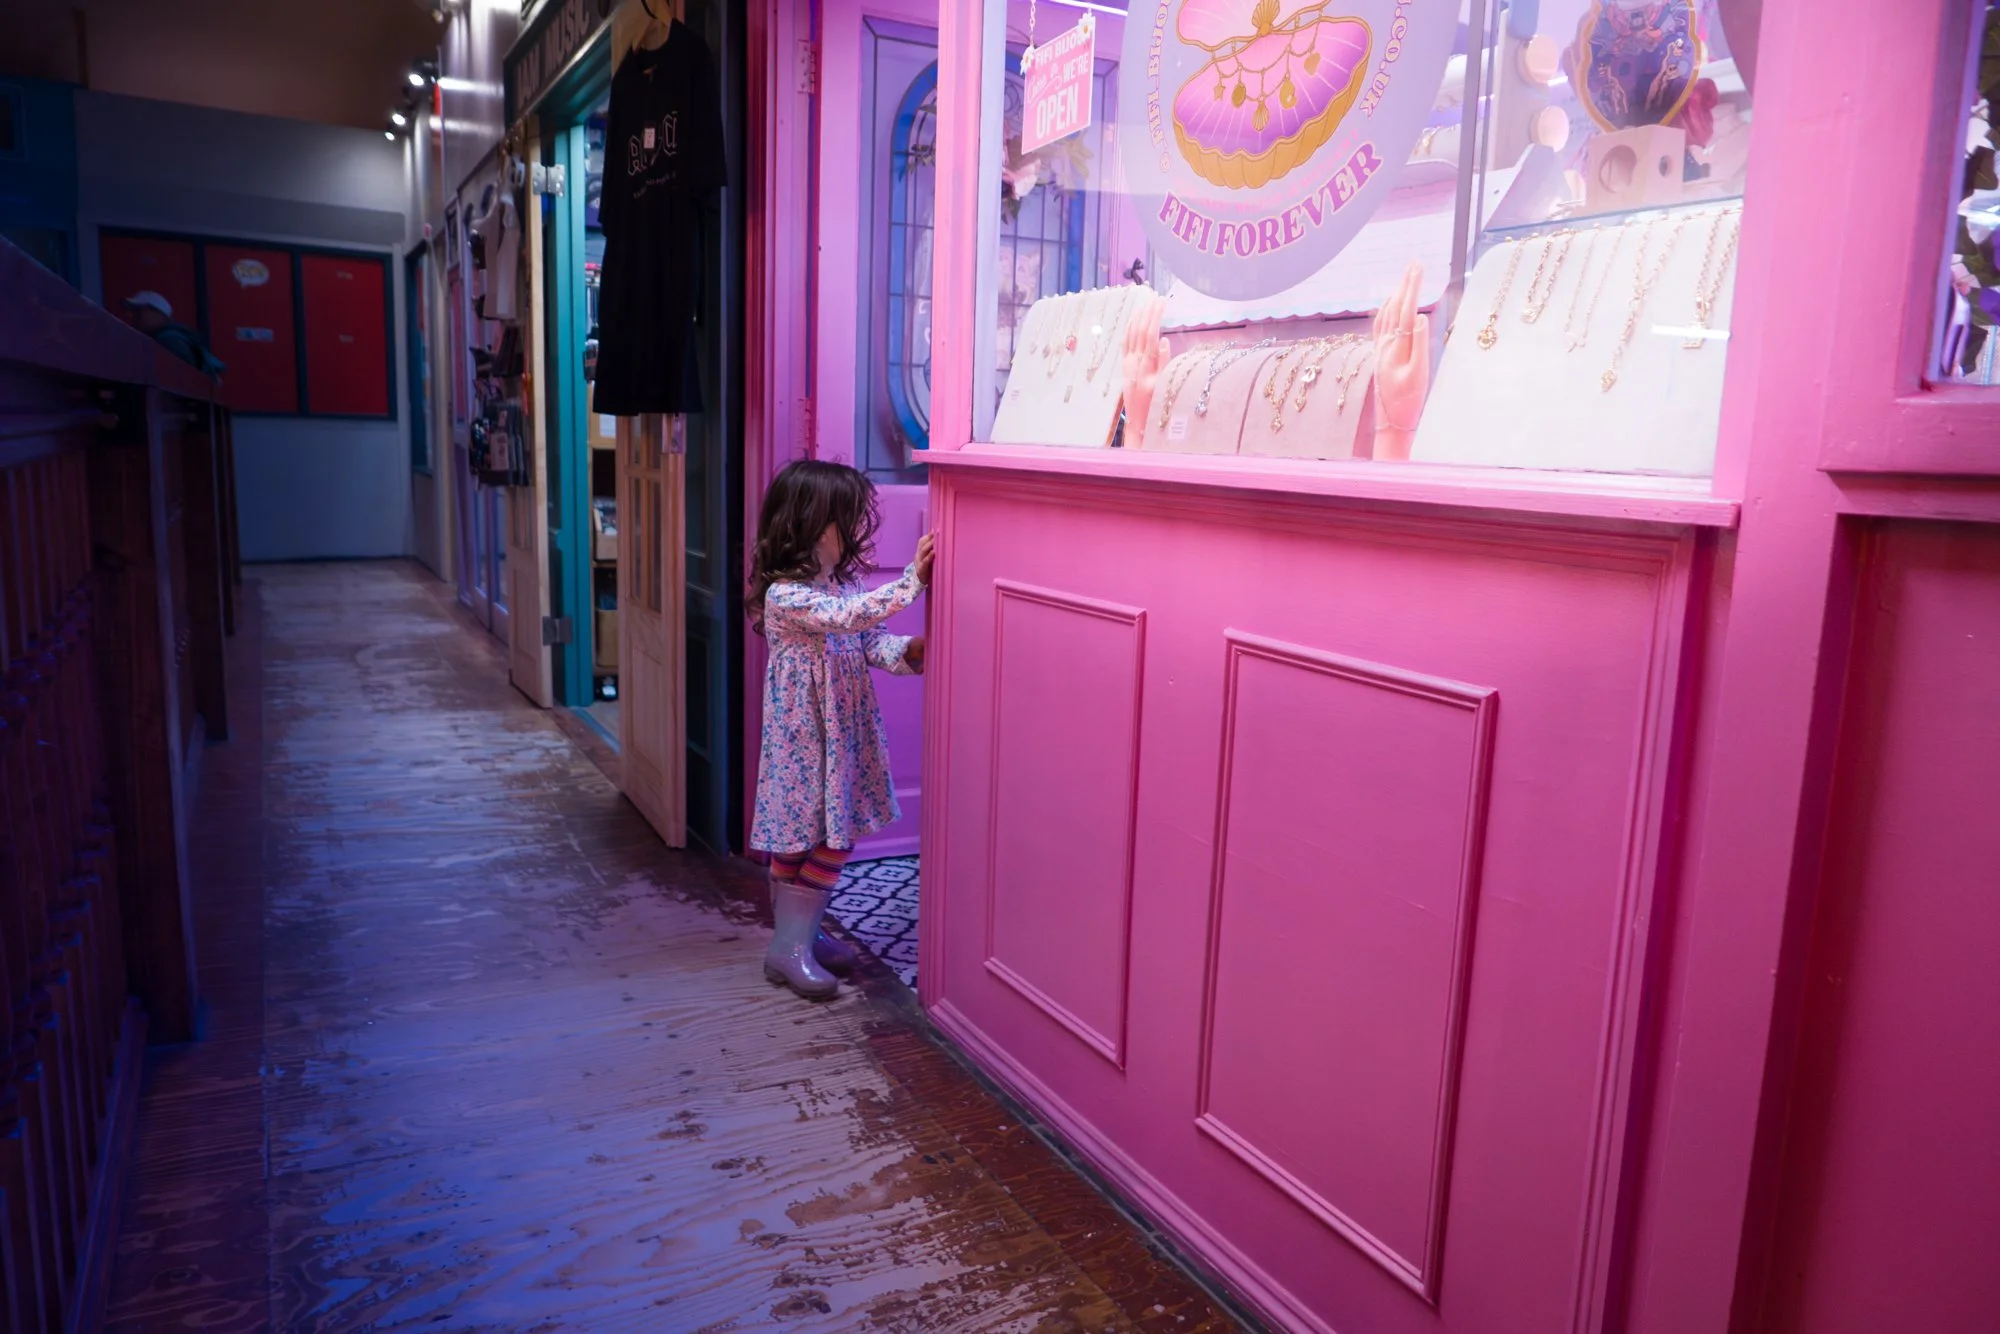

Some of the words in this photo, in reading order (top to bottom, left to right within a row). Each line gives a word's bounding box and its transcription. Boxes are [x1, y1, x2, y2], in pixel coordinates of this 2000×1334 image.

[1035, 45, 1053, 68] FIFI
[1063, 52, 1089, 83] WE'RE
[1036, 82, 1080, 140] OPEN
[1159, 191, 1213, 251] FIFI
[1214, 141, 1383, 258] FOREVER
